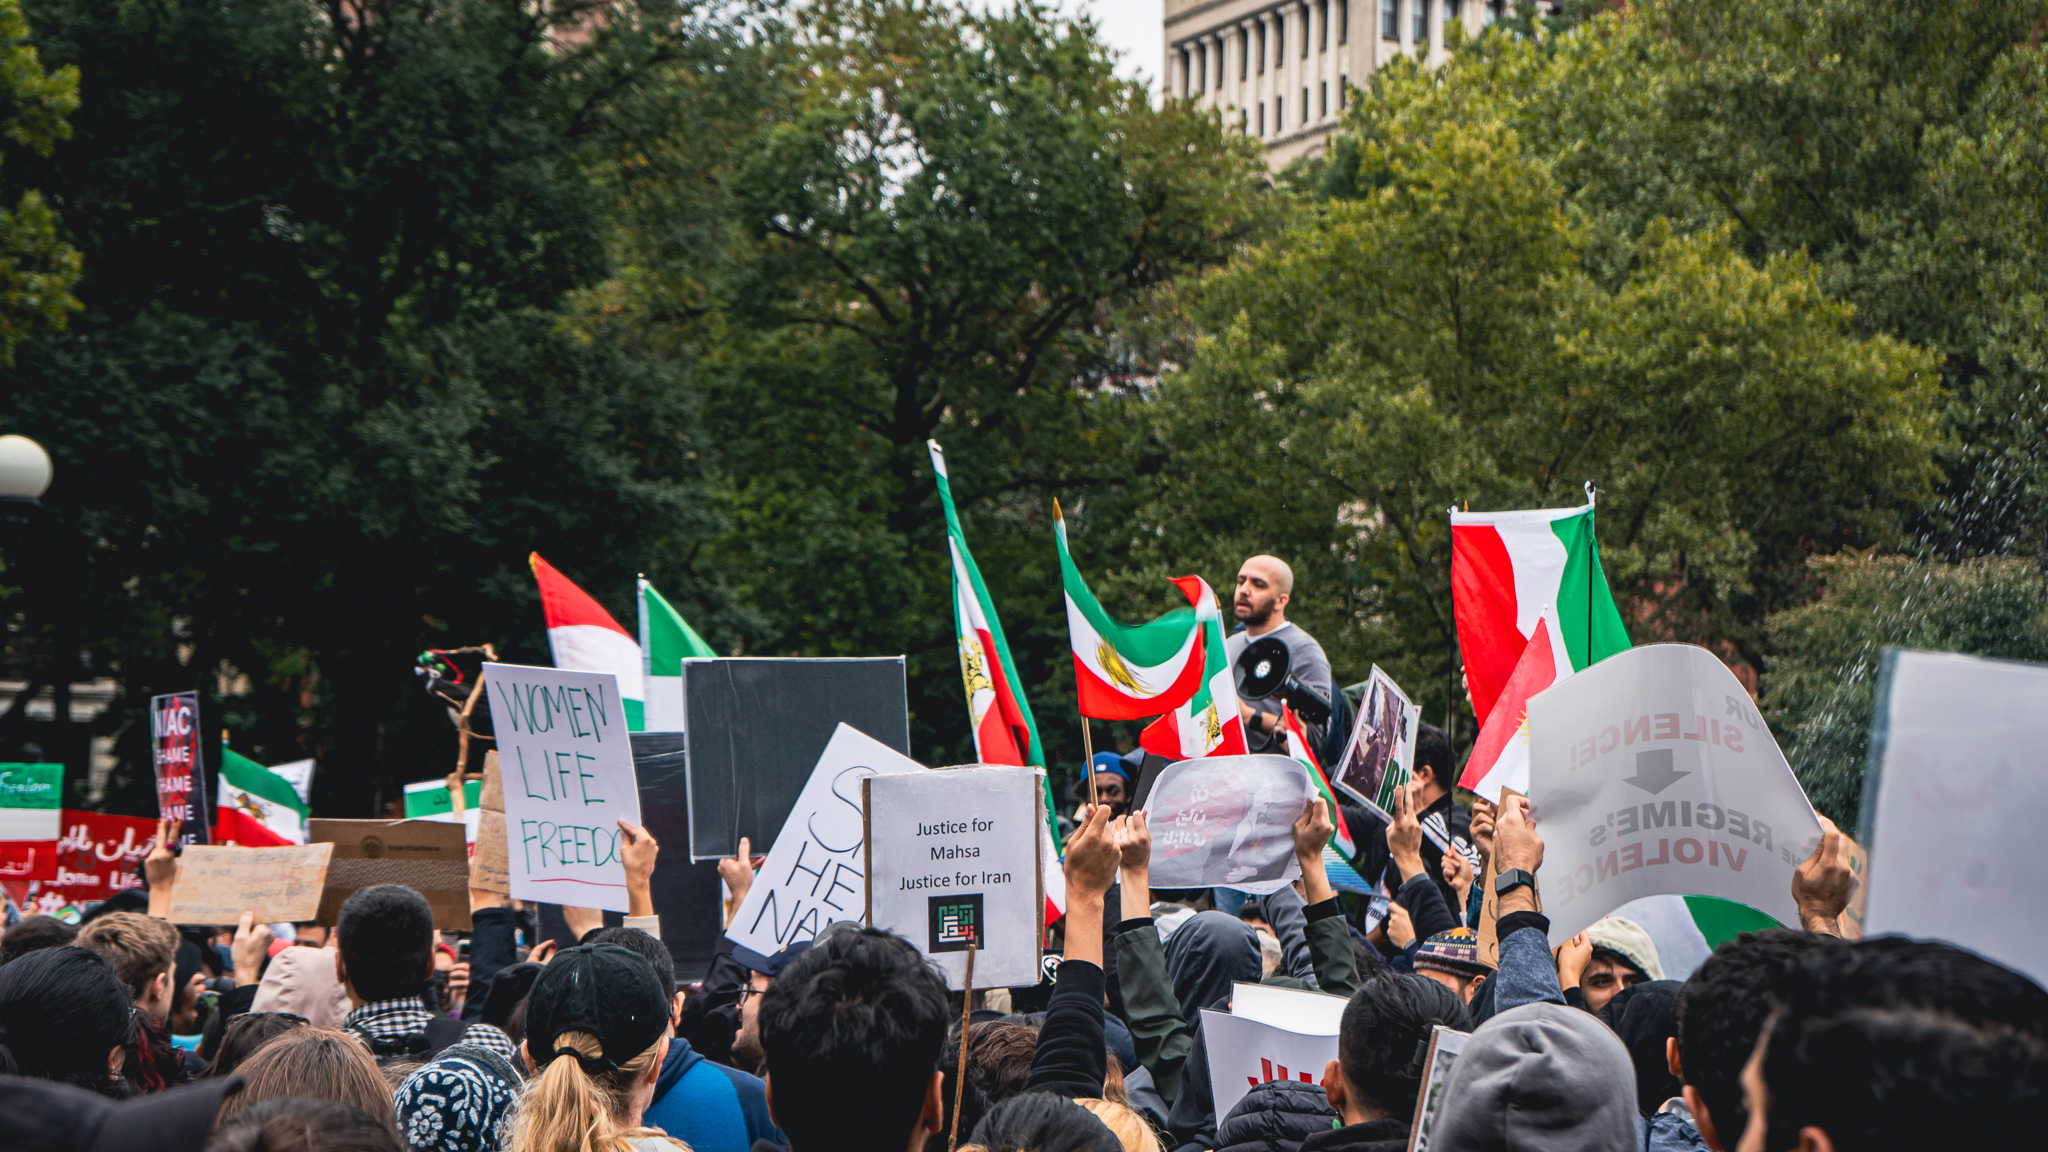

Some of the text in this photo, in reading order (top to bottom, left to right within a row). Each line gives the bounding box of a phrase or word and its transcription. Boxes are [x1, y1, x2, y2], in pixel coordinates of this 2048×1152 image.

[154, 706, 191, 737] NIAC
[496, 680, 607, 743] WOMEN
[517, 746, 605, 806] LIFE
[916, 817, 994, 837] Justice for
[930, 844, 981, 860] Mahsa
[786, 840, 865, 912] HE
[900, 871, 1011, 890] Justice for Iran
